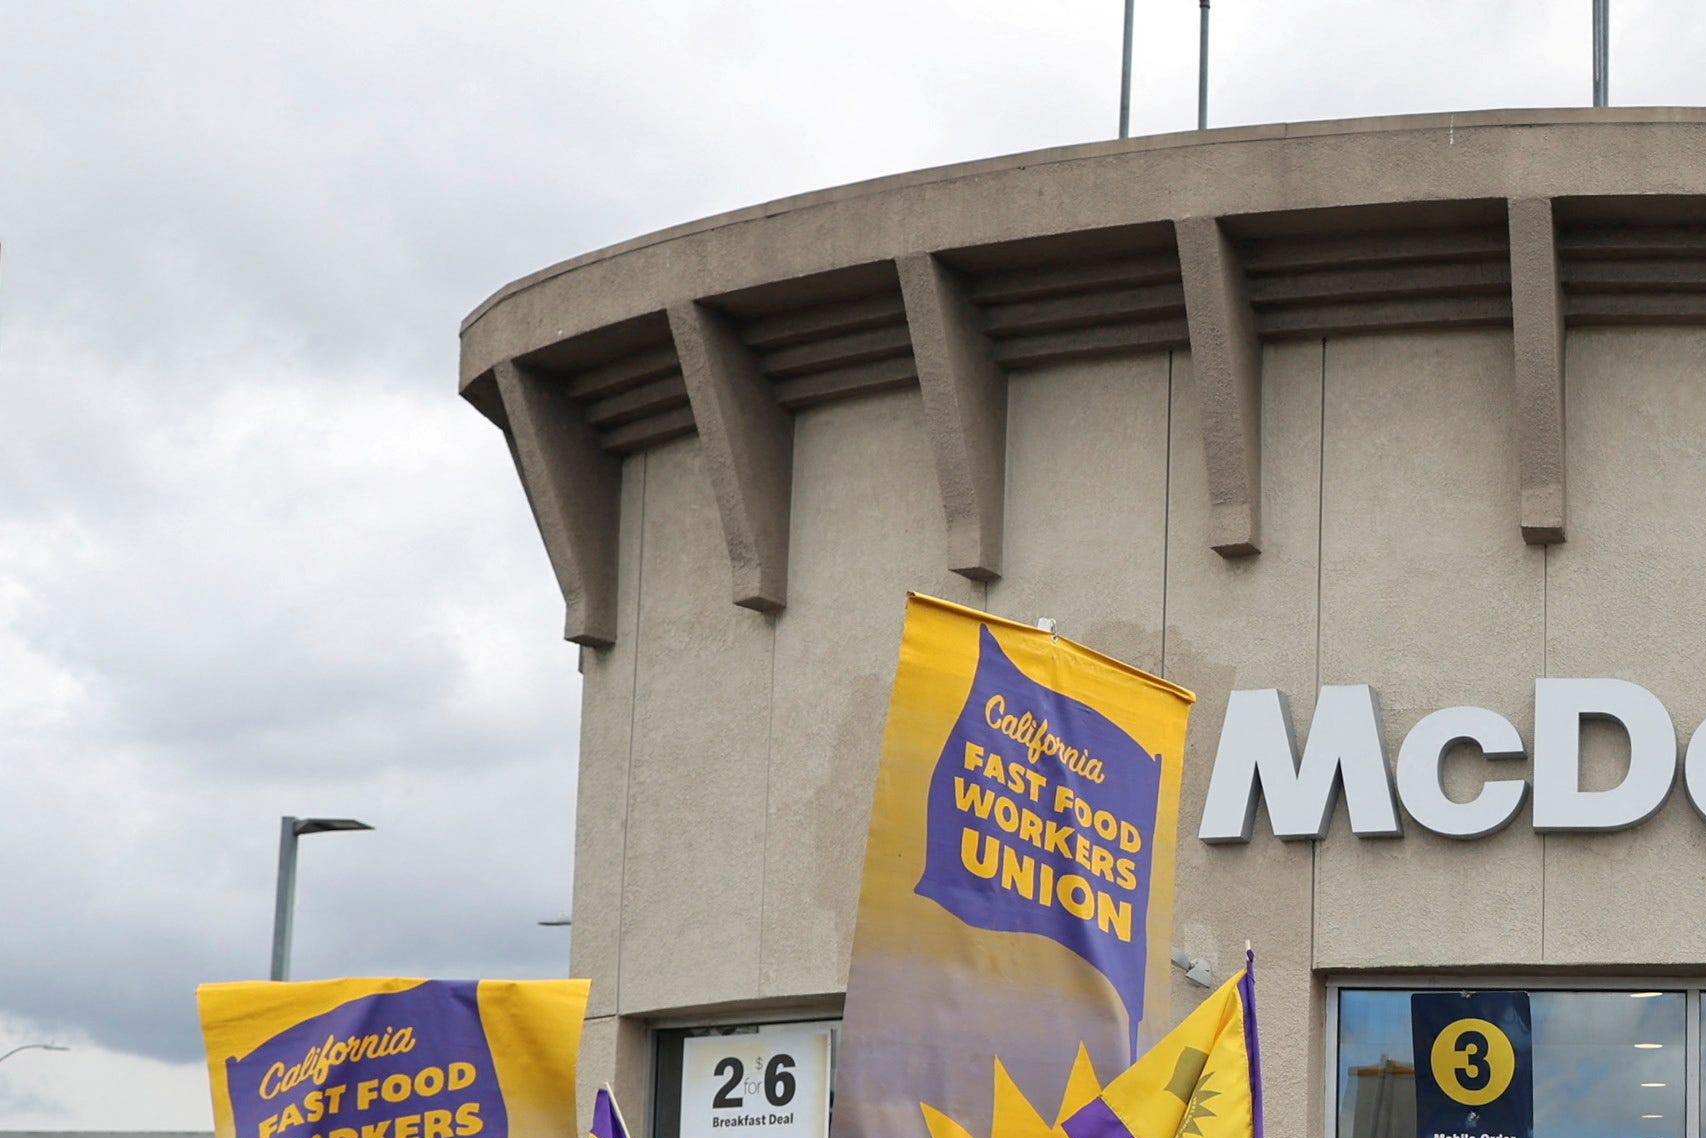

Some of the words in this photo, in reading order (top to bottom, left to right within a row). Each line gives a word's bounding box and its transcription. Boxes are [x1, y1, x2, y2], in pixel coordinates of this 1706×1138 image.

[985, 694, 1105, 784] California
[954, 776, 1137, 891] WORKERS
[964, 741, 1047, 802] FAST
[1054, 785, 1142, 853] FOOD
[961, 827, 1132, 943] UNION
[259, 1026, 416, 1100] California
[357, 1061, 477, 1110] FOOD
[712, 1056, 744, 1109] 2
[743, 1077, 762, 1095] for
[1454, 1030, 1491, 1090] 3
[712, 1114, 766, 1128] Breakfast
[769, 1113, 794, 1125] Deal
